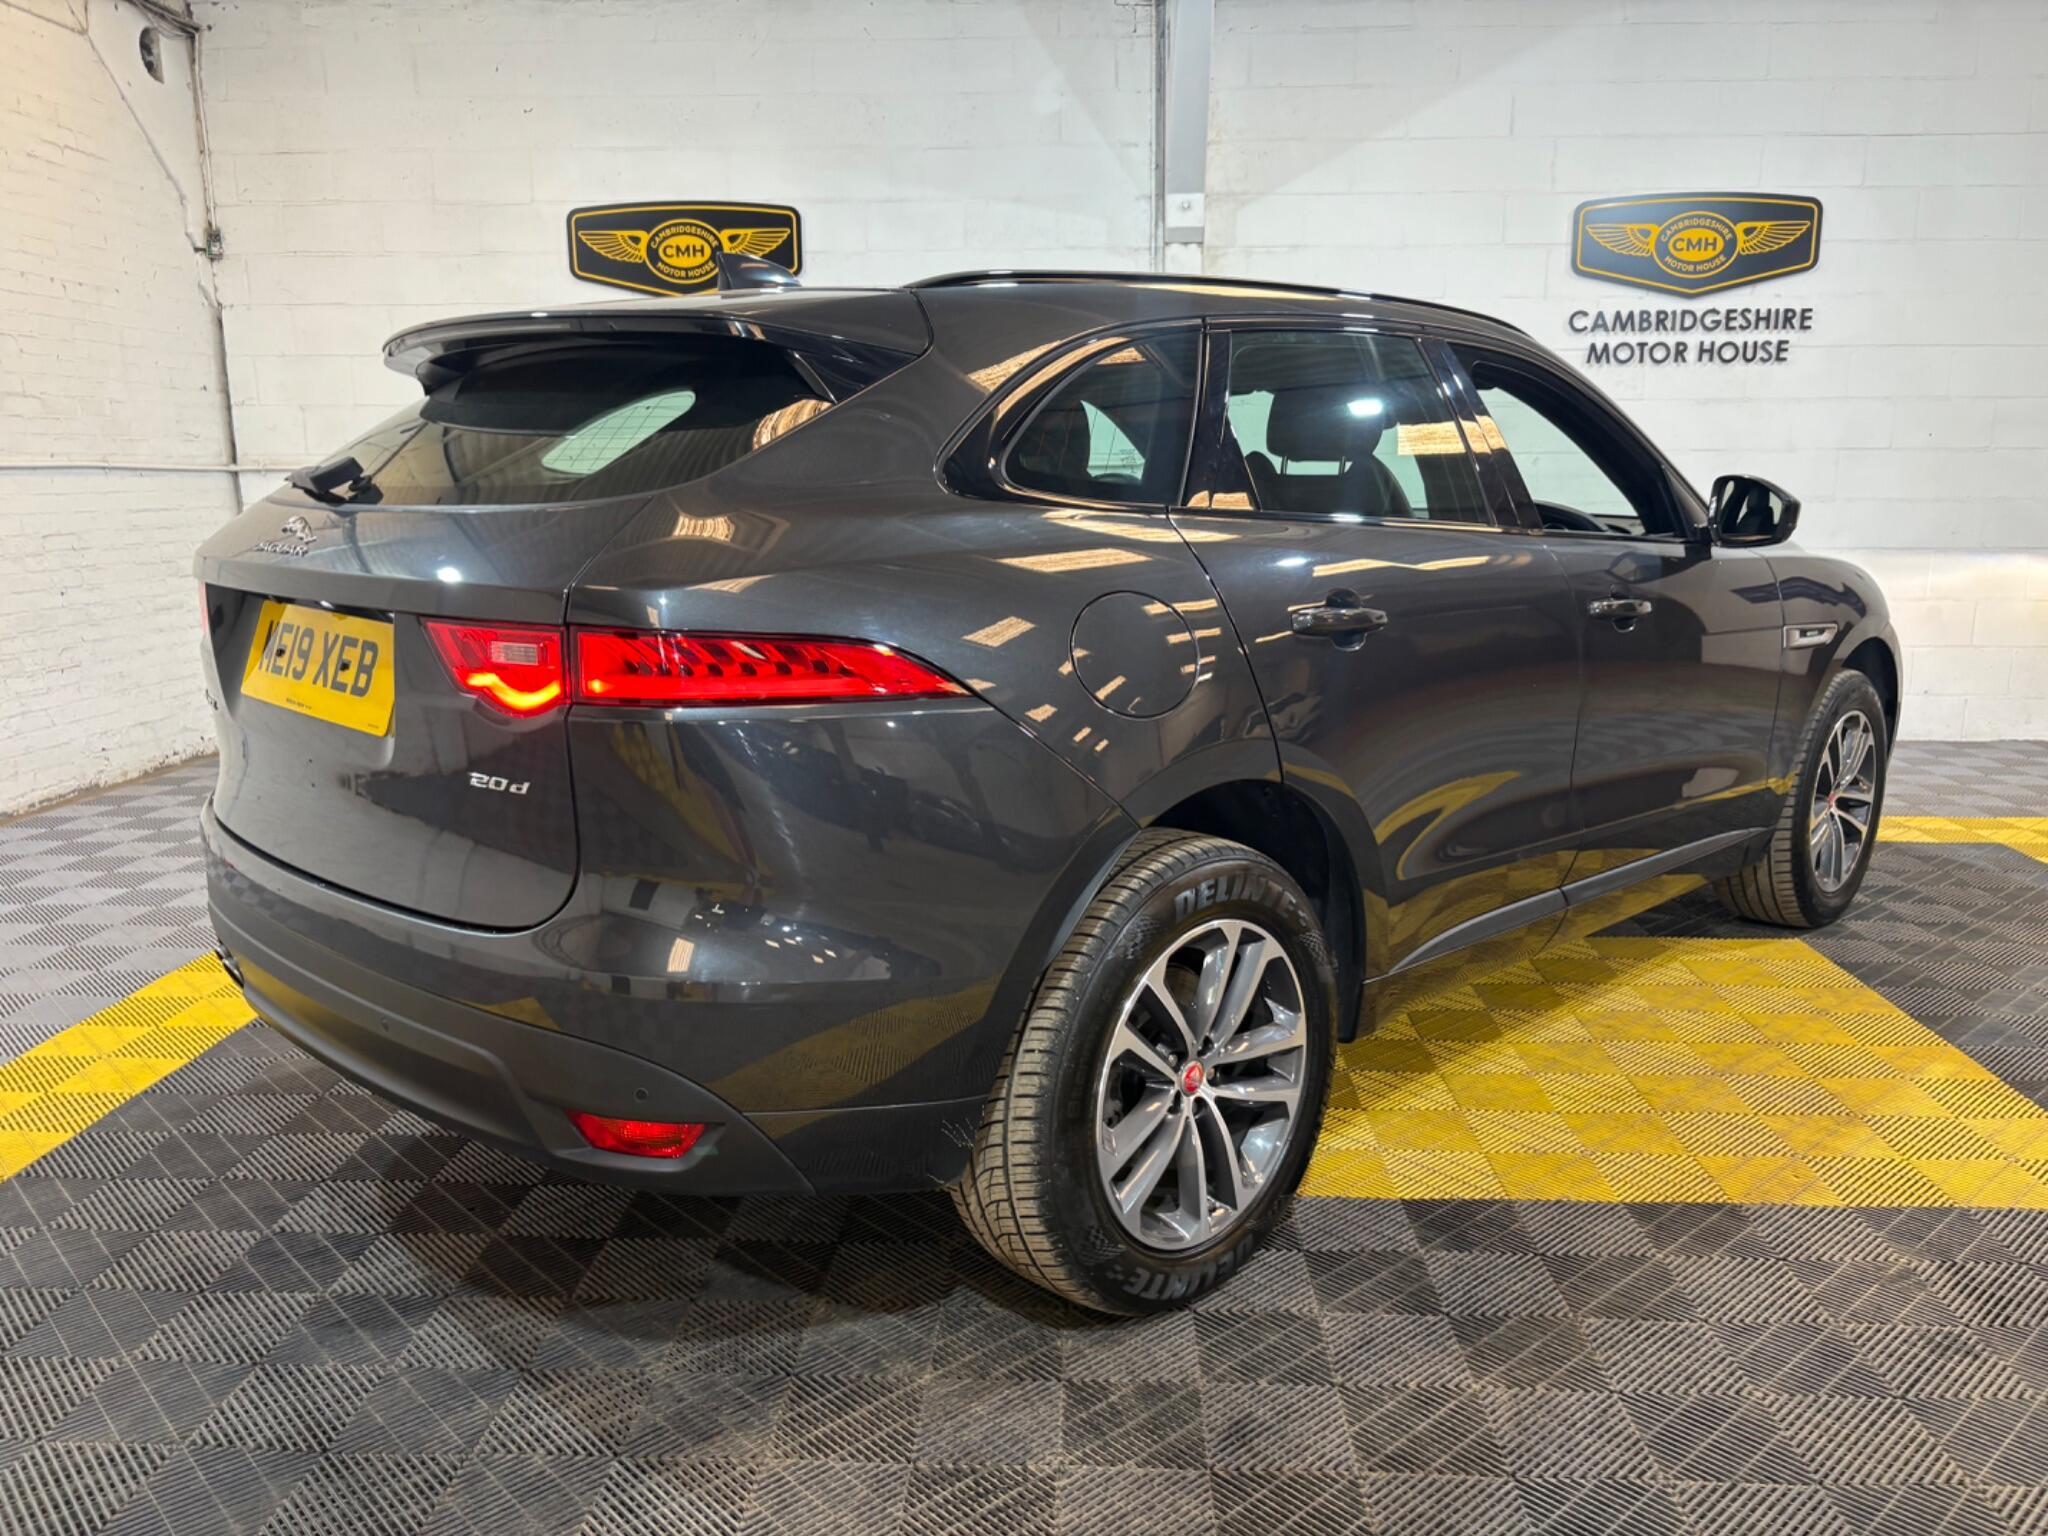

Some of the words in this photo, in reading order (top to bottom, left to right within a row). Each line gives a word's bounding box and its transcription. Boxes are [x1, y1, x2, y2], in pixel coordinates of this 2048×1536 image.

[650, 224, 721, 249] CAMBRIDGESHIRE
[1661, 217, 1733, 243] CAMBRIDGESHIRE
[662, 244, 706, 259] CMH
[1671, 237, 1718, 252] CMH
[655, 261, 687, 278] MOTOR
[687, 260, 717, 278] HOUSE
[1664, 255, 1695, 272] MOTOR
[1695, 254, 1727, 272] HOUSE
[1568, 307, 1813, 333] CAMBRIDGESHIRE
[1586, 341, 1688, 364] MOTOR
[1696, 340, 1790, 363] HOUSE
[257, 619, 315, 682] ME19
[312, 631, 380, 698] XEB
[466, 771, 531, 796] 20d
[1175, 872, 1296, 922] DELINTE
